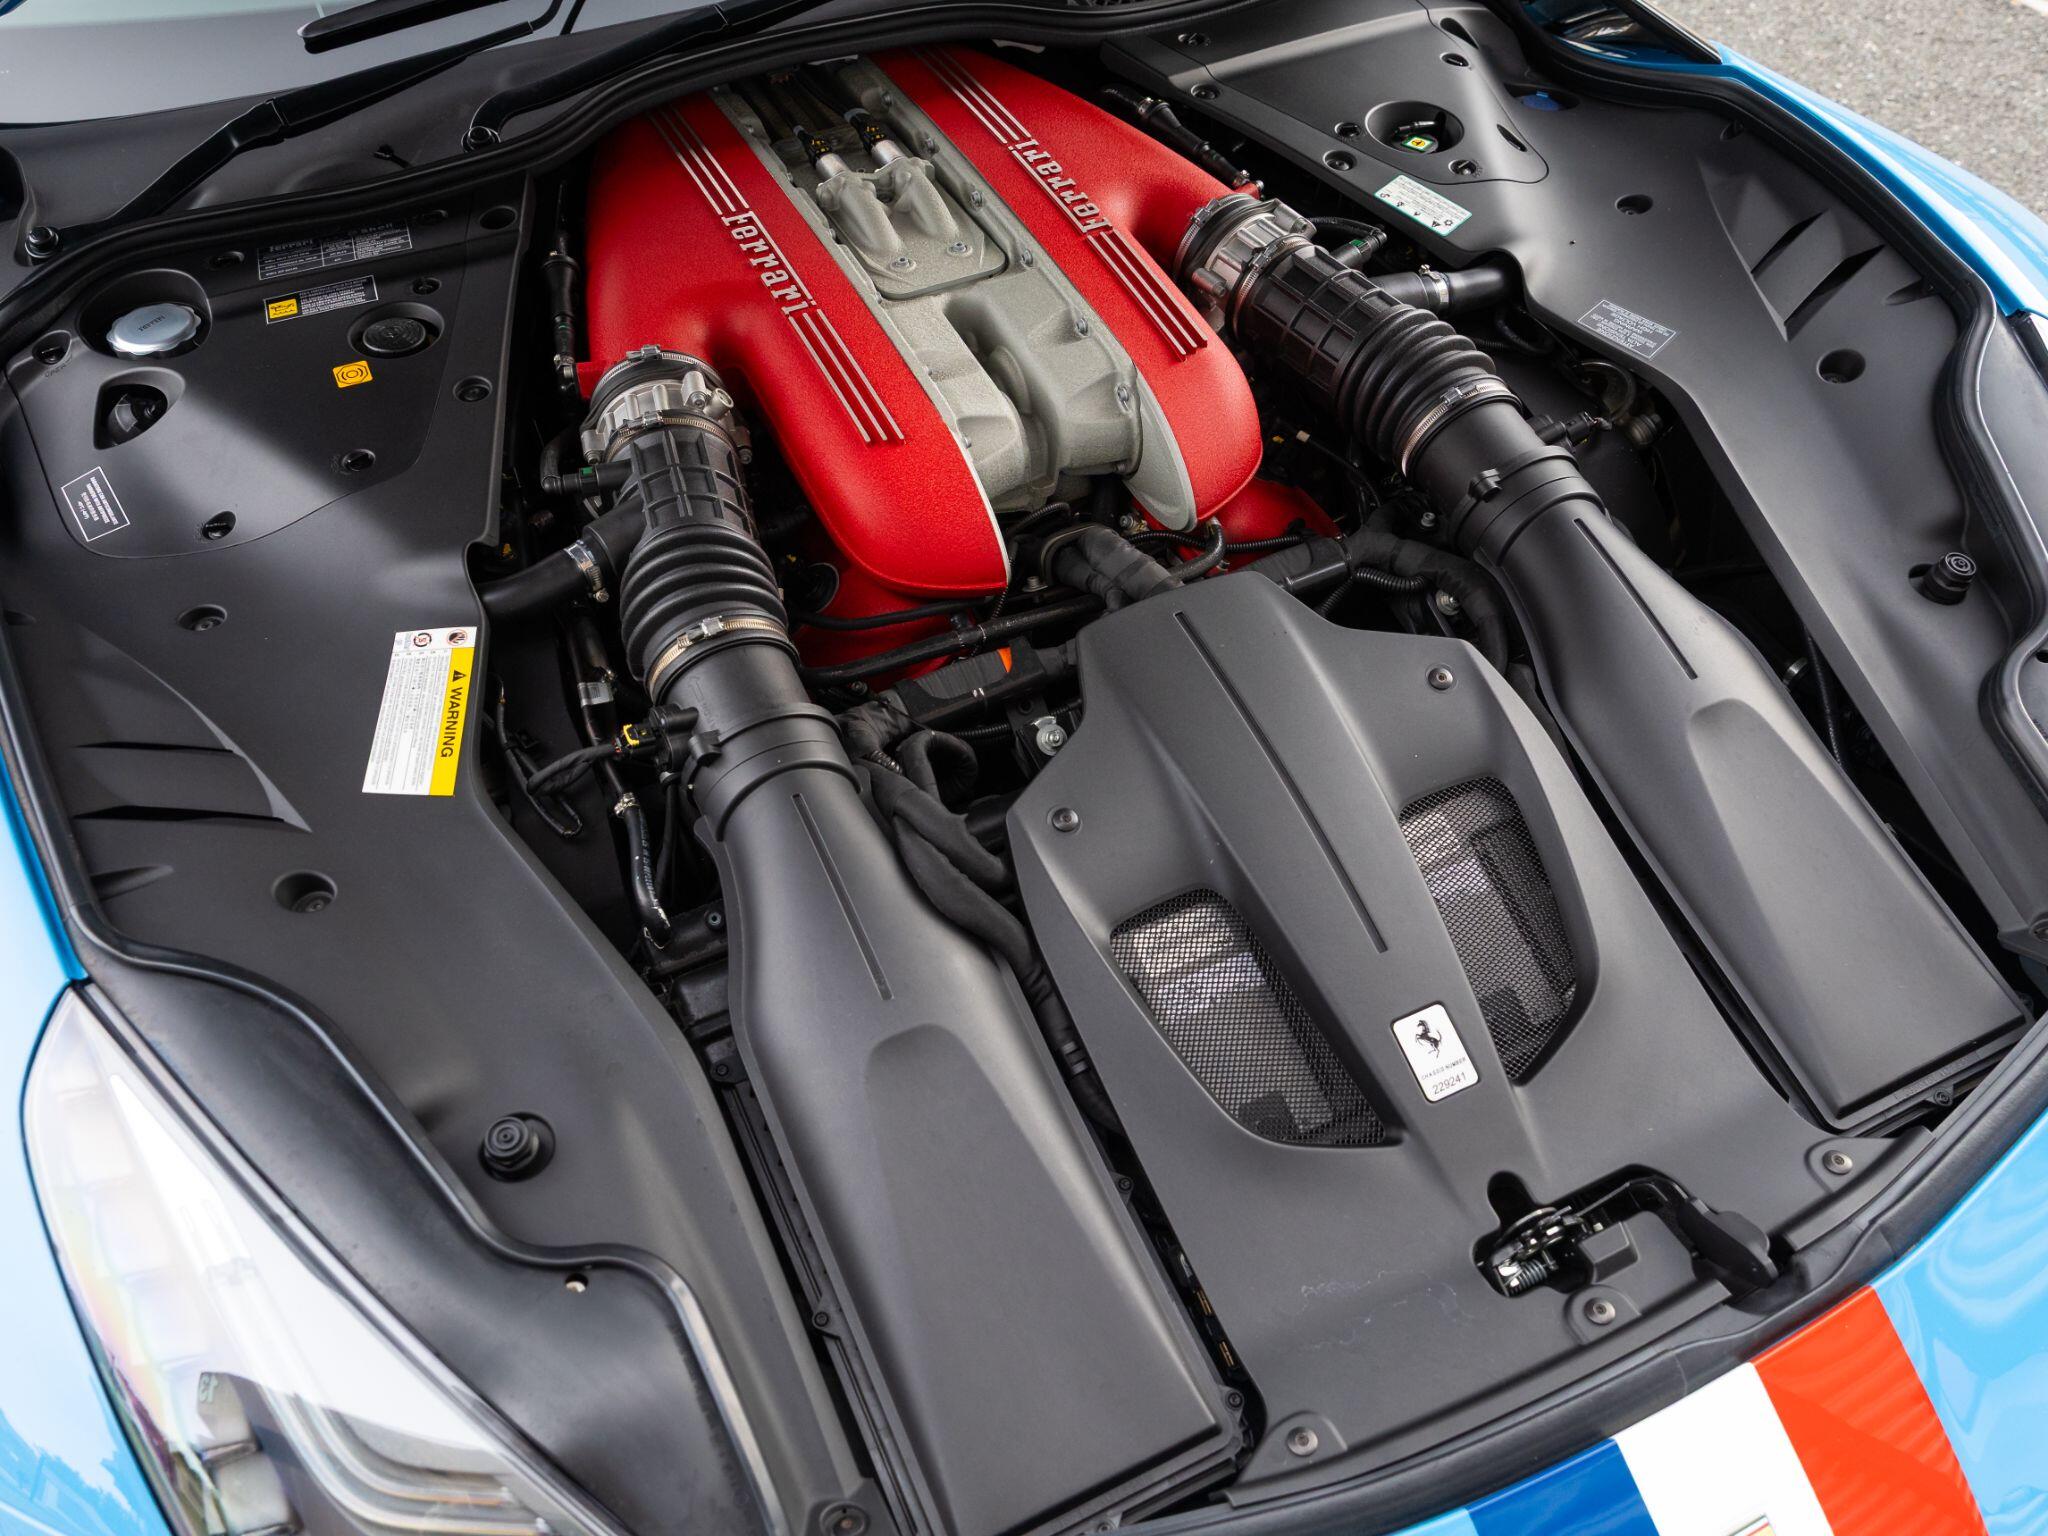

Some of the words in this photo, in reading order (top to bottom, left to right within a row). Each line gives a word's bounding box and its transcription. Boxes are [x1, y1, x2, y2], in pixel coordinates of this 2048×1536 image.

[1008, 139, 1112, 233] Ferrari
[721, 211, 816, 315] Ferrari
[440, 687, 463, 758] WARNING
[1432, 1072, 1466, 1095] 229241
